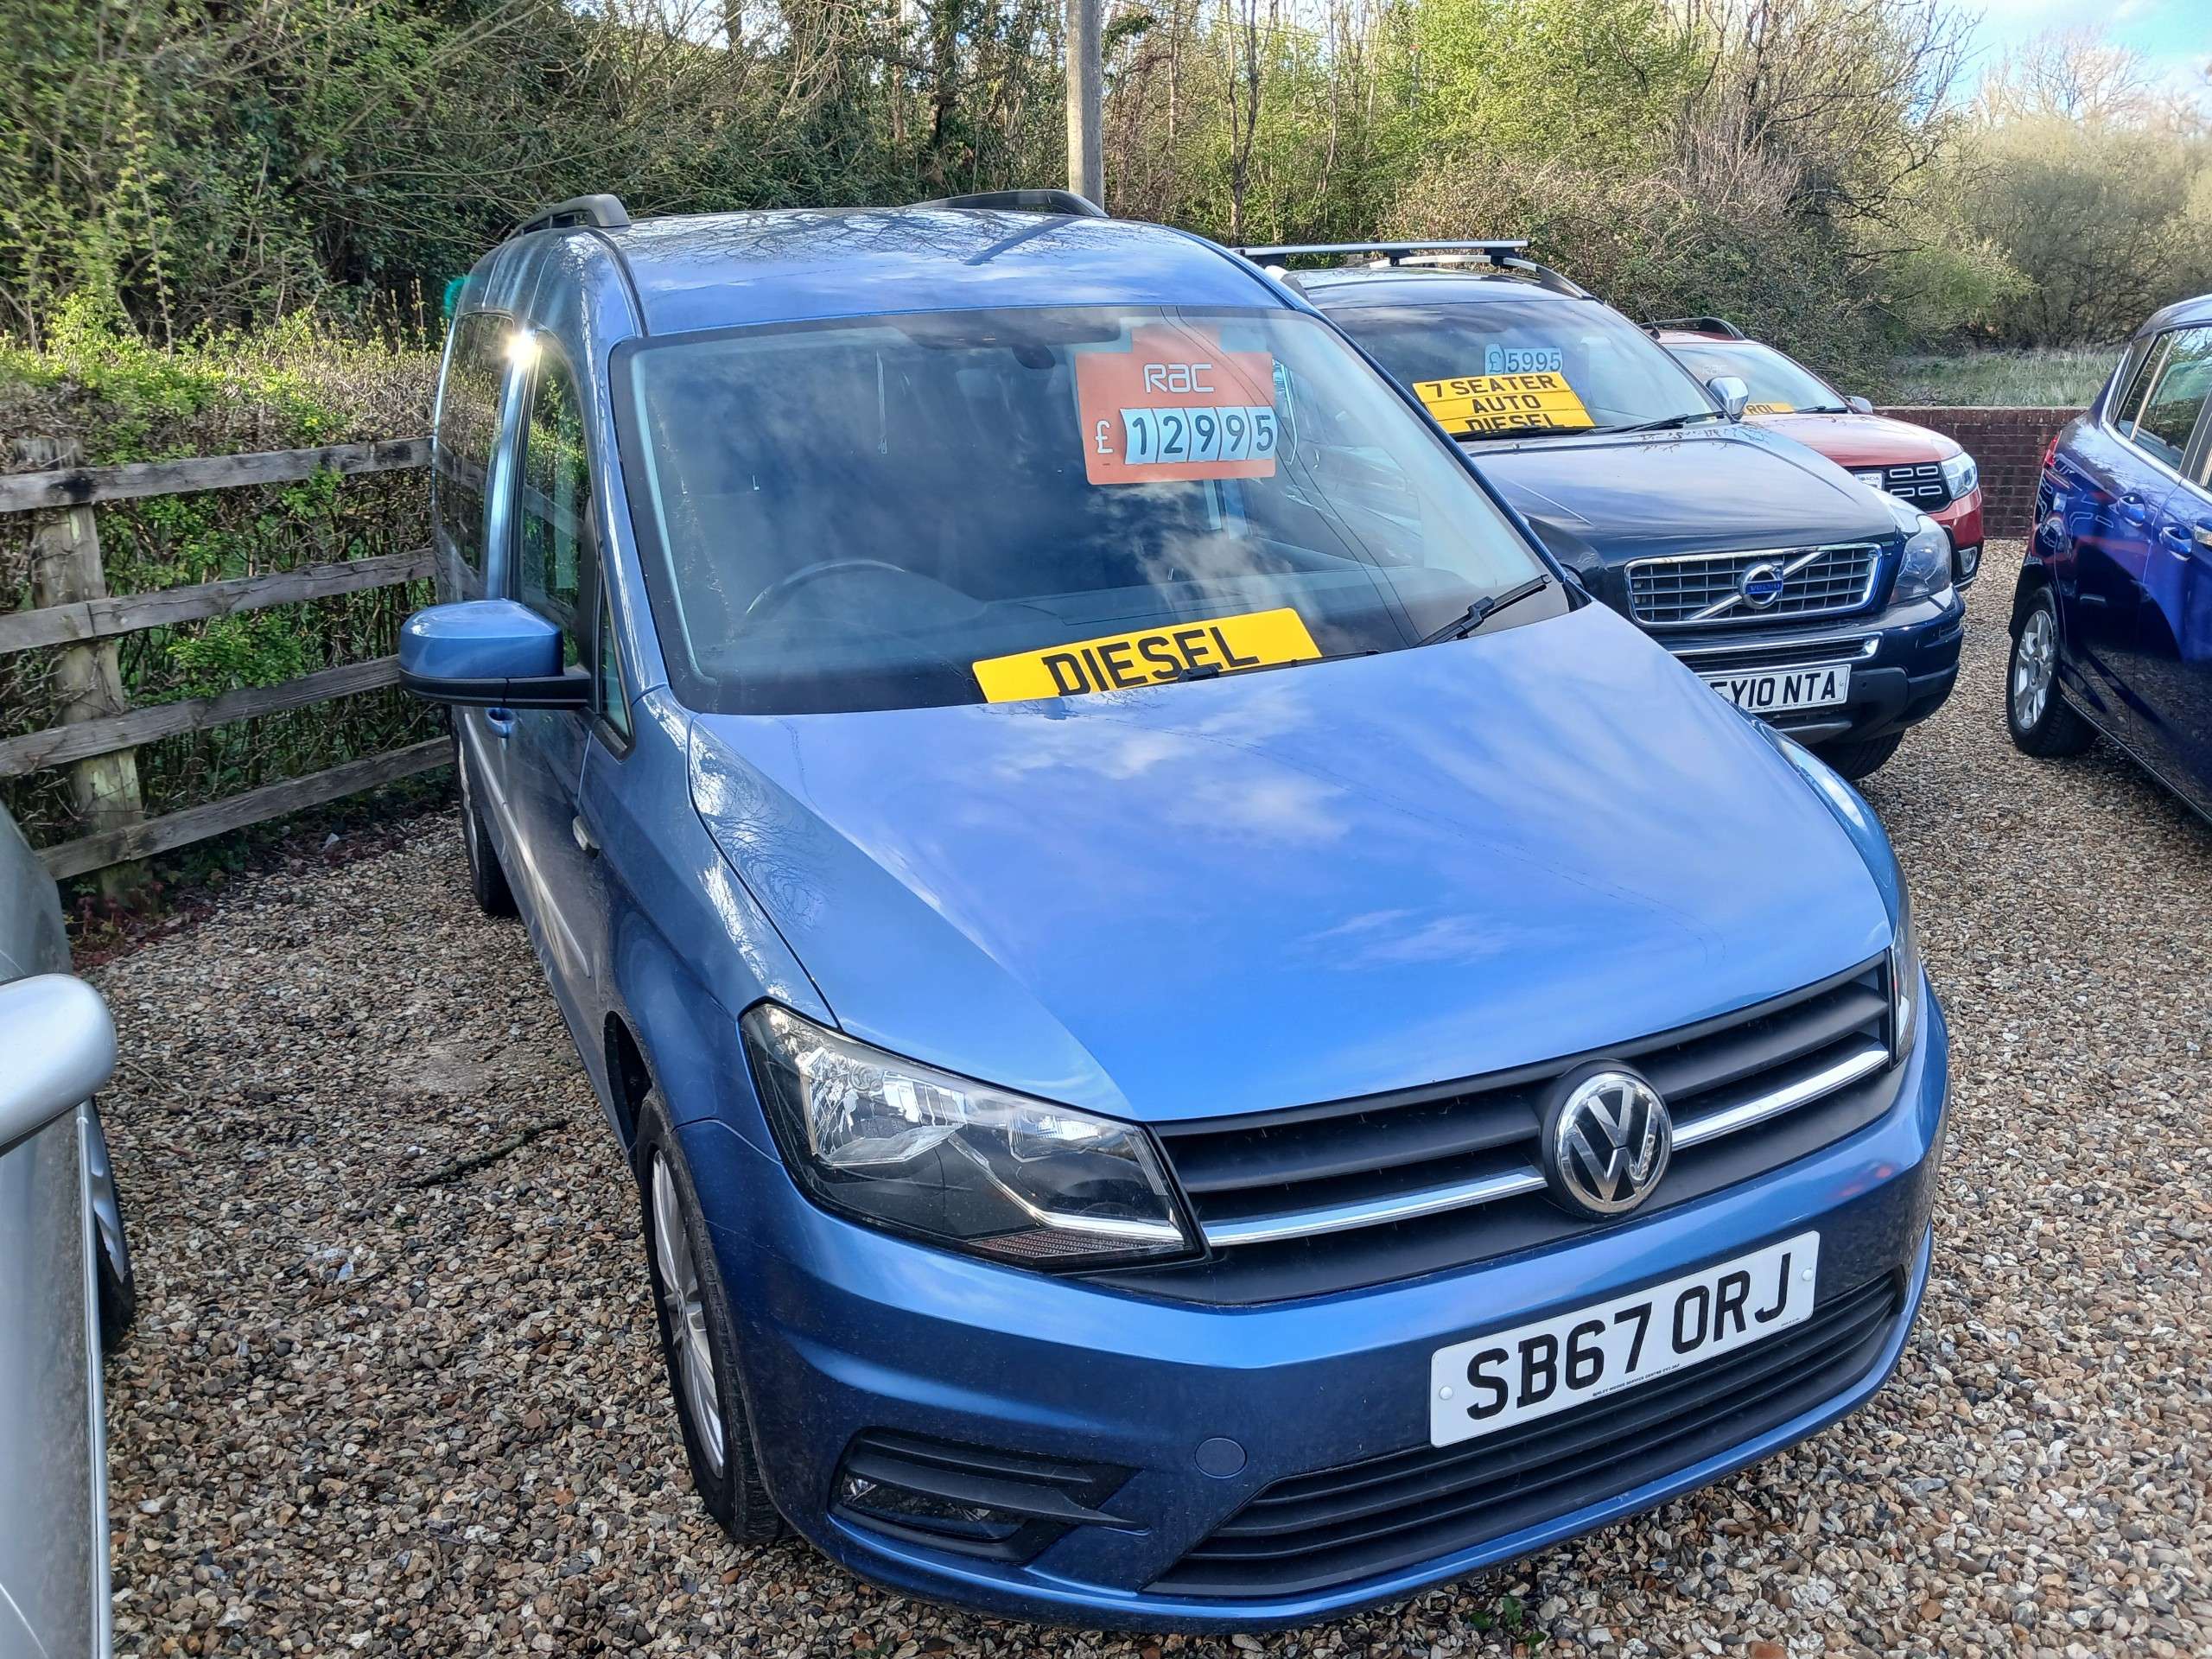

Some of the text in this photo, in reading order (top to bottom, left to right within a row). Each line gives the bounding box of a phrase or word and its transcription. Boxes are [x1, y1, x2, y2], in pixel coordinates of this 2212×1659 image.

[1489, 351, 1561, 373] £5995
[1425, 375, 1557, 398] 7 SEATER
[1471, 395, 1541, 414] AUTO
[1095, 415, 1274, 455] £ 12995
[1041, 626, 1260, 697] DIESEL
[1783, 671, 1836, 704] NTA
[1466, 1252, 1791, 1421] SB67 ORJ
